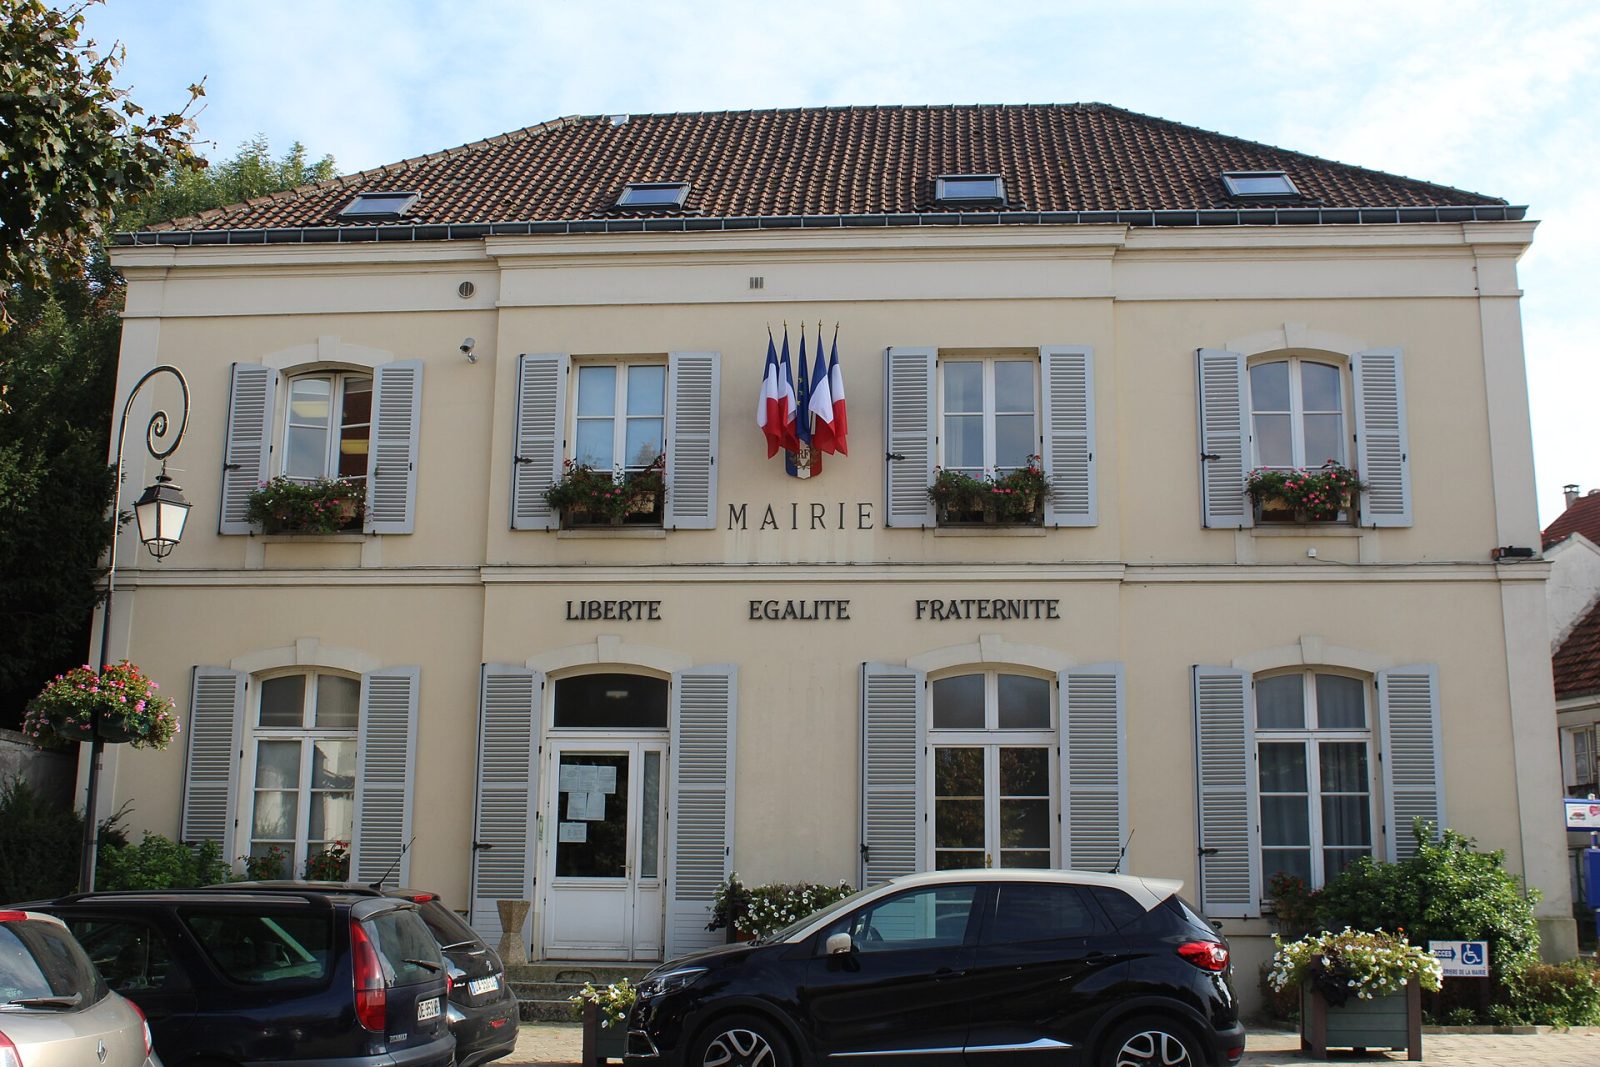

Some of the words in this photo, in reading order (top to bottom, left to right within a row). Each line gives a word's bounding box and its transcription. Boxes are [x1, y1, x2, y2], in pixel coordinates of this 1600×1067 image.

[727, 502, 874, 531] MAIRIE
[565, 600, 662, 622] LIBERTE
[748, 600, 851, 621] EGALITE
[915, 599, 1061, 621] FRATERNITE
